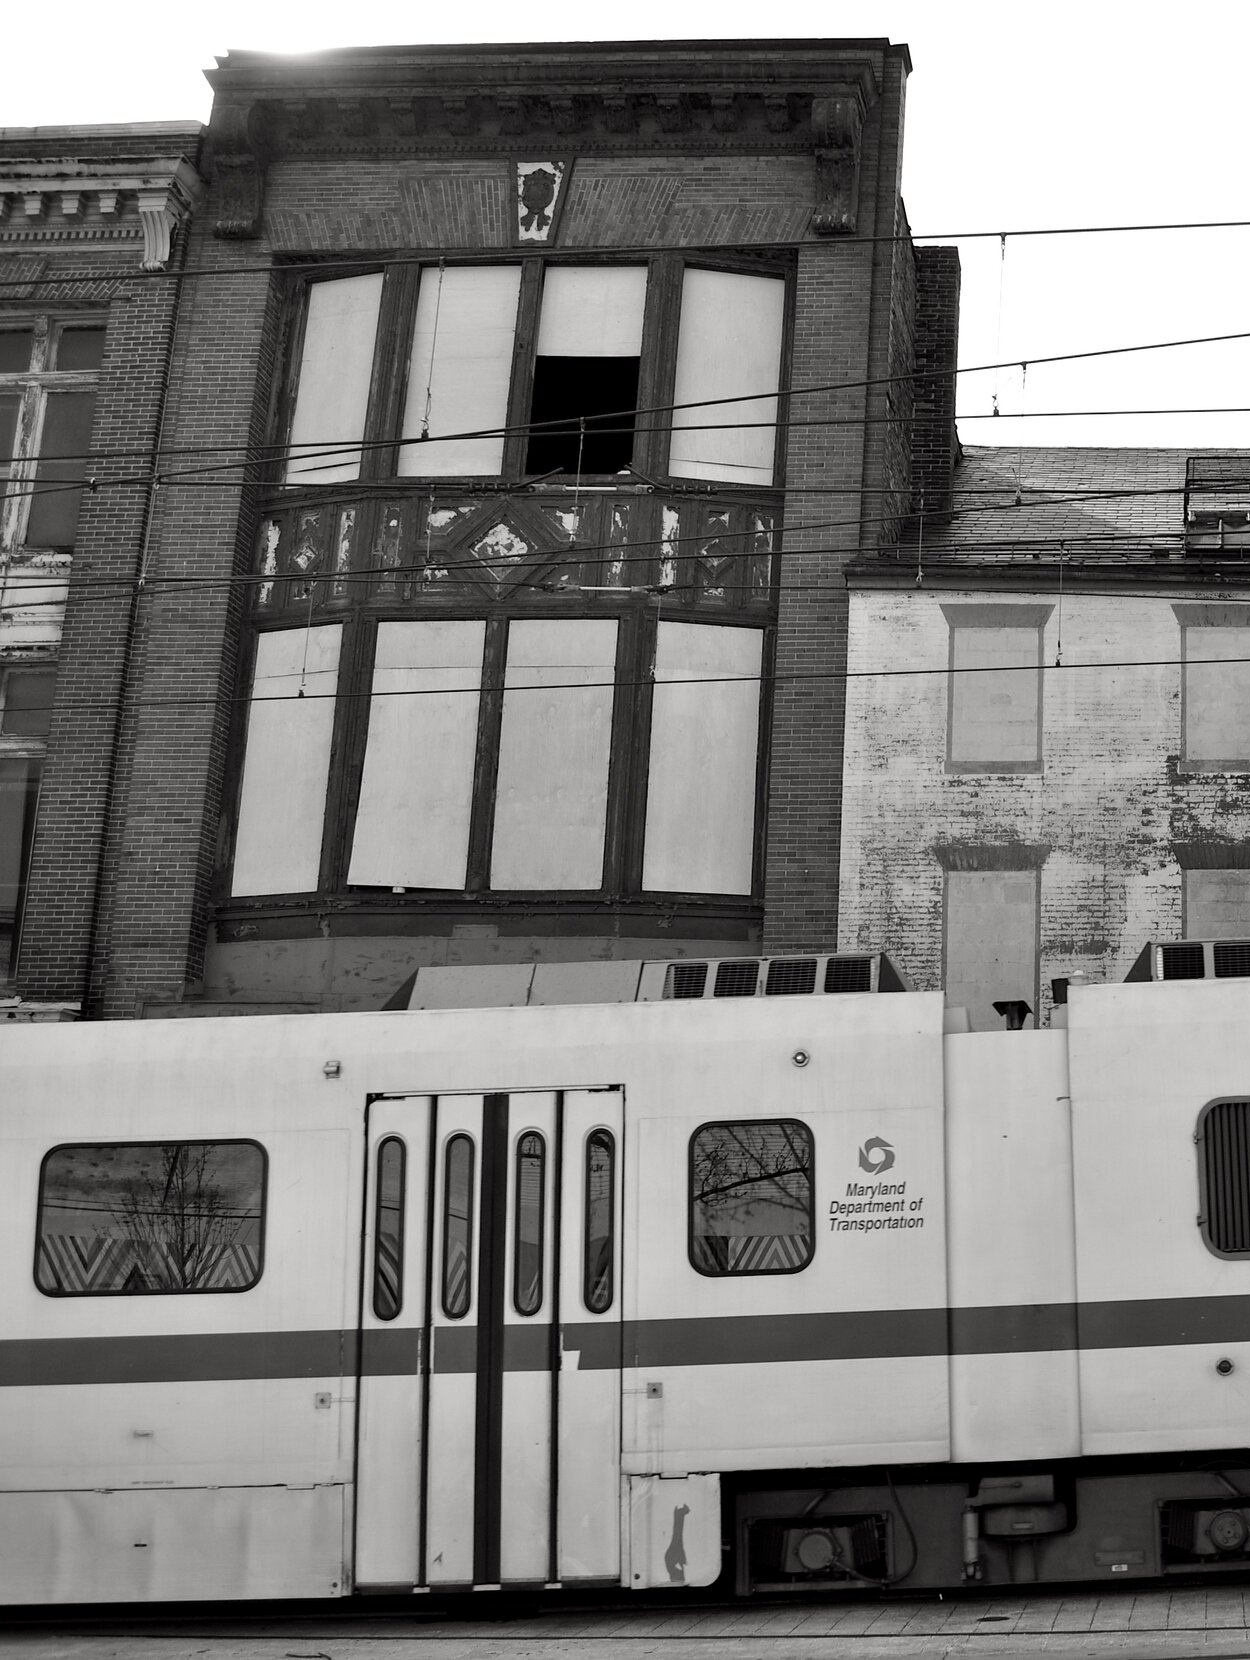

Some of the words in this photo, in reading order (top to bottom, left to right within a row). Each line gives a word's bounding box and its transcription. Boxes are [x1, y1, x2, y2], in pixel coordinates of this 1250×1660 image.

[846, 1181, 906, 1199] Maryland
[829, 1199, 905, 1217] Department
[909, 1197, 924, 1211] of
[829, 1216, 924, 1233] Transportation
